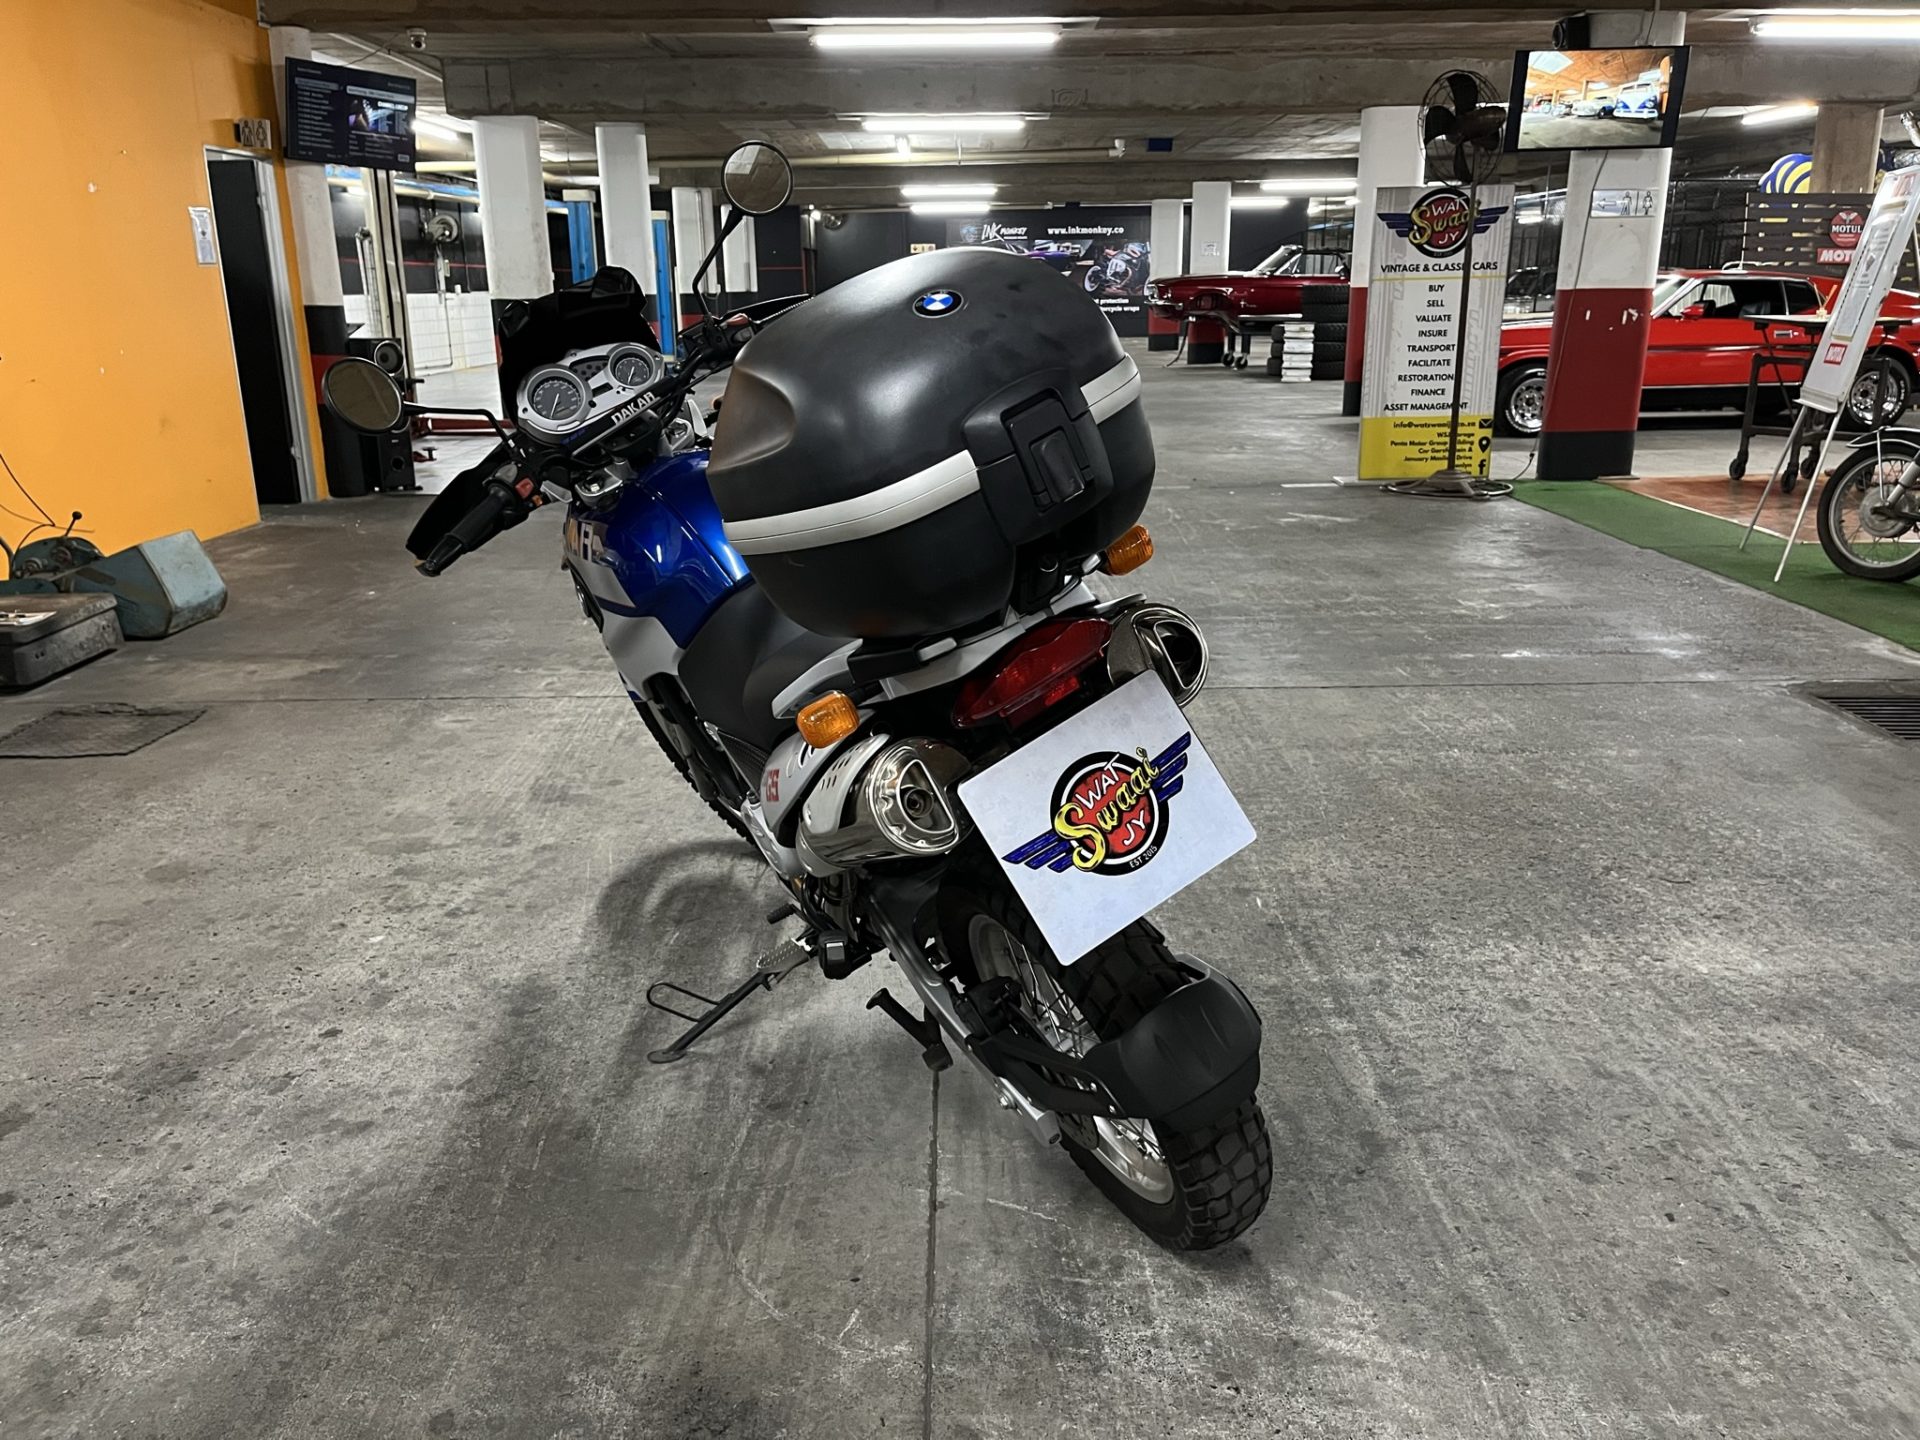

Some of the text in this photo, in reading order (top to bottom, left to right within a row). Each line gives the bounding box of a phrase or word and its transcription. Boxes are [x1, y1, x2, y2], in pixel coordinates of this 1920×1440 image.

[1431, 196, 1467, 216] WAT
[1047, 226, 1125, 236] www.inkmonkey.co
[1831, 225, 1864, 233] MOTUL
[1438, 231, 1459, 244] JY
[1820, 249, 1857, 263] MOT
[1380, 264, 1420, 273] VINTAGE
[1422, 264, 1430, 272] &
[1472, 261, 1498, 270] CARS
[1428, 284, 1445, 292] BUY
[1426, 299, 1445, 307] SELL
[1415, 314, 1452, 323] VALUATE
[1418, 329, 1448, 337] INSURE
[1407, 344, 1456, 352] TRANSPORT
[1408, 359, 1451, 367] FACILITATE
[1397, 374, 1454, 382] RESTORATION
[1410, 388, 1446, 396] FINANCE
[1384, 402, 1468, 411] ASSET MANAGEMNT
[1075, 753, 1120, 810] WAT
[1123, 809, 1146, 846] JY
[1129, 845, 1158, 868] EST 2015
